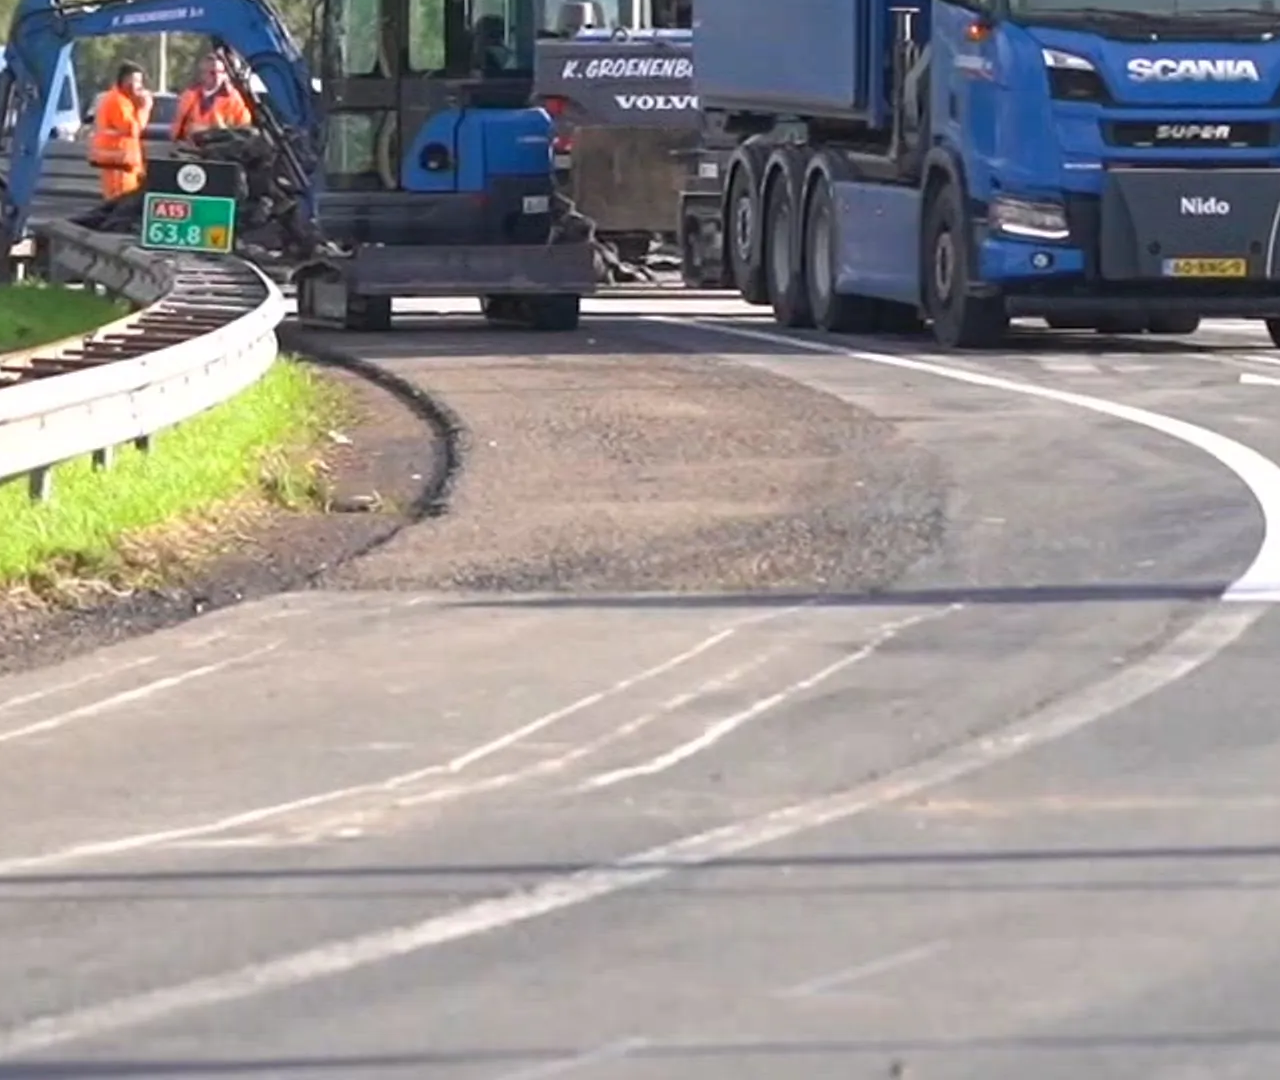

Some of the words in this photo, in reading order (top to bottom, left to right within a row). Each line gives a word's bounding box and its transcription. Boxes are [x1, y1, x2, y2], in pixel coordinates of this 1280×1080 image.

[1127, 58, 1260, 82] SCANIA
[1156, 124, 1231, 140] SUPER
[155, 202, 186, 219] A15
[1180, 196, 1231, 215] Nido
